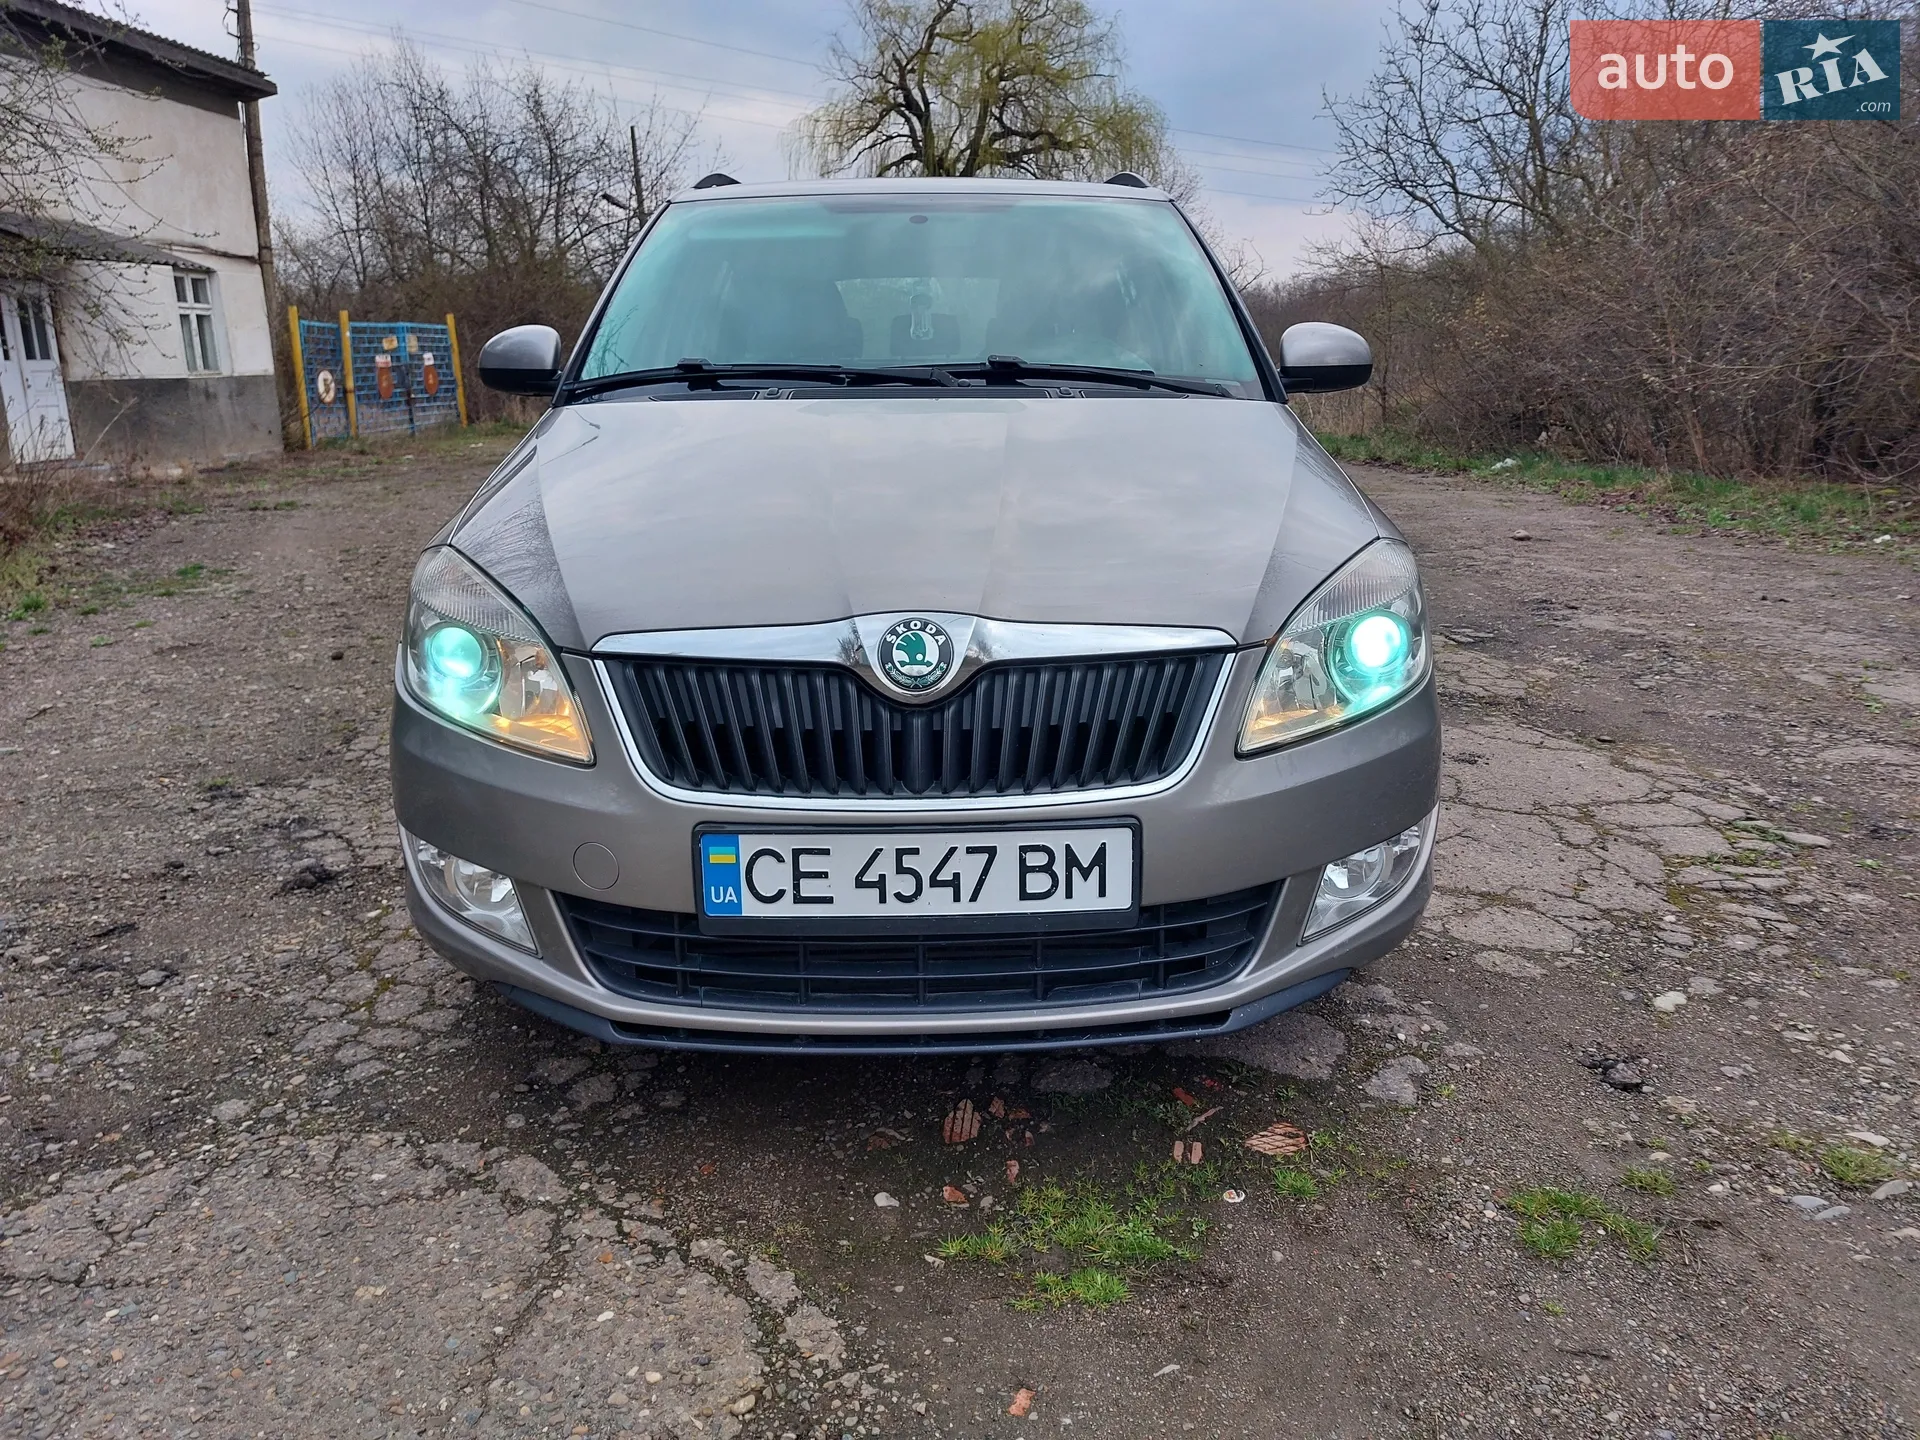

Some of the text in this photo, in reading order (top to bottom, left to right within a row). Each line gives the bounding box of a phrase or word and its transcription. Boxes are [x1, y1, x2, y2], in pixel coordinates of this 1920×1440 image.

[885, 620, 947, 646] SKODA
[744, 841, 1107, 905] CE 4547 BM
[710, 887, 738, 904] UA
